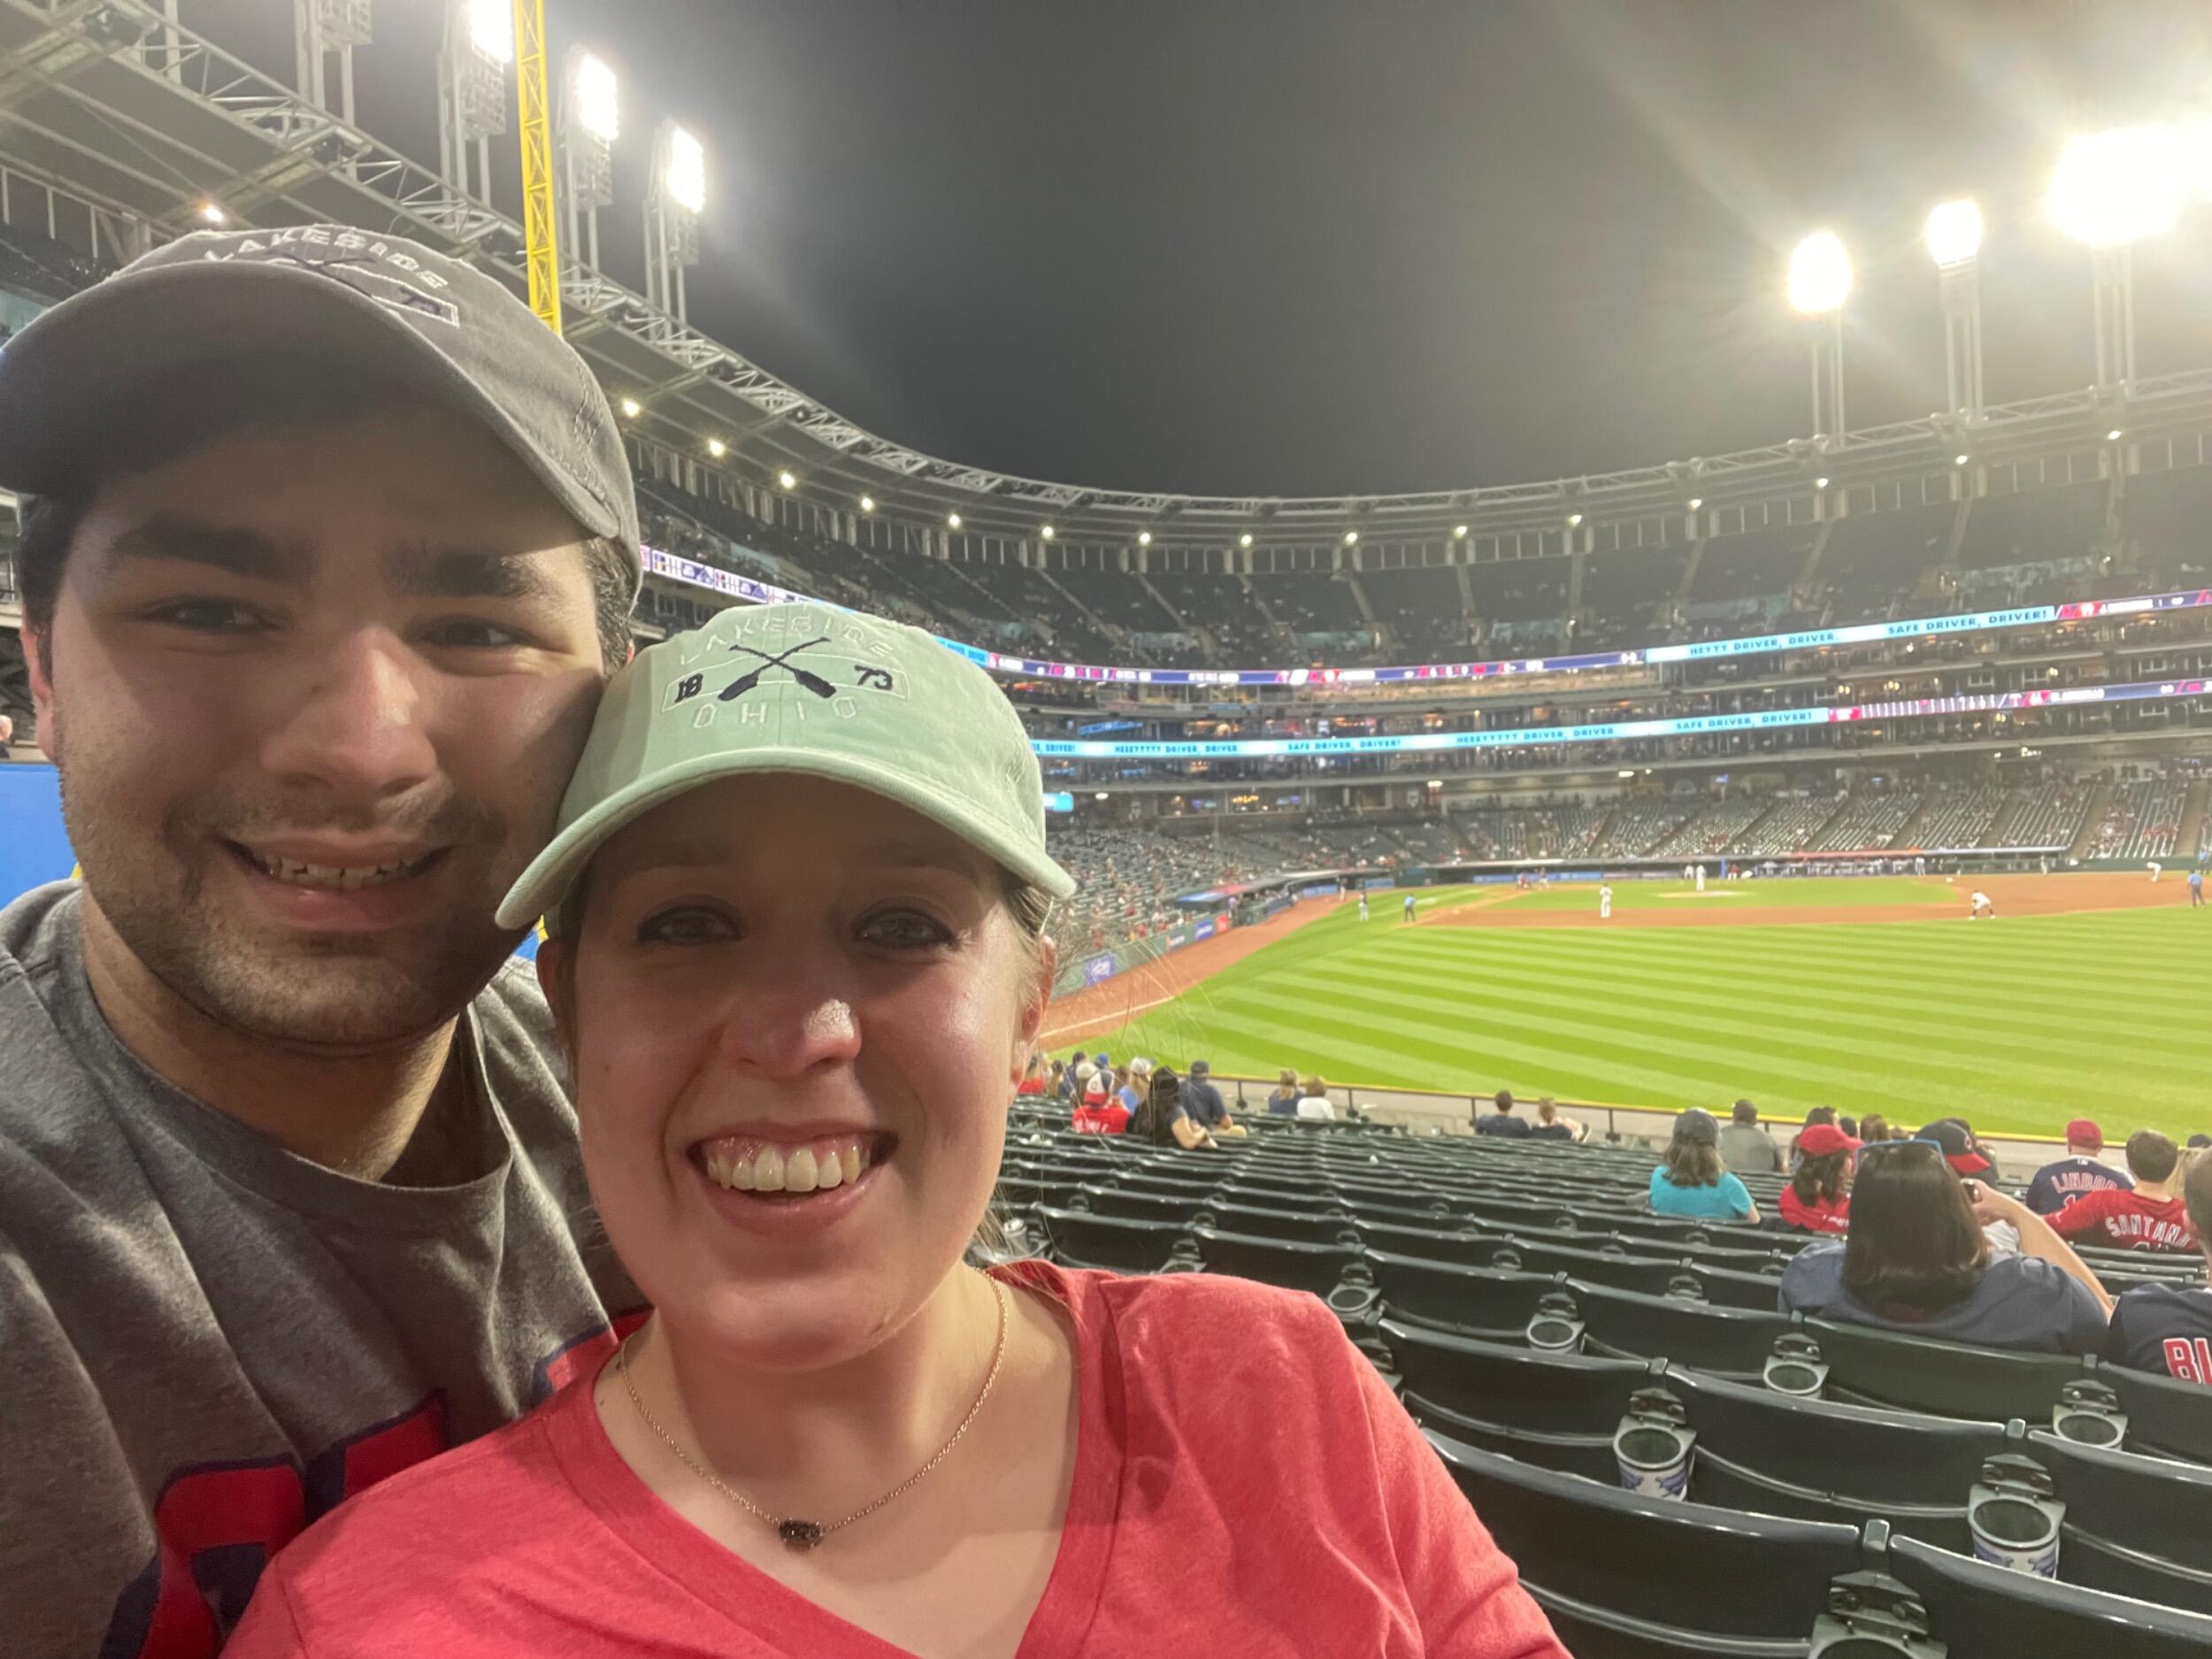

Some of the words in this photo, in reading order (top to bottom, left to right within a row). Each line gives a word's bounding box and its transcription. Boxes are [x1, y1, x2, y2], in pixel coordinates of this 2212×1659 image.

[1888, 623, 1919, 634] SAFE
[1926, 618, 1981, 630] DRIVER,
[1988, 610, 2047, 624] DRIVER!
[680, 615, 893, 664] LAKESIDE
[1690, 644, 1727, 656] HEYYY
[675, 673, 703, 703] 18
[854, 664, 893, 690] 73
[694, 696, 856, 728] OHIO
[1676, 721, 1702, 730] SAFE
[1763, 711, 1812, 723] DRIVER!
[2051, 1171, 2118, 1194] LINDOR
